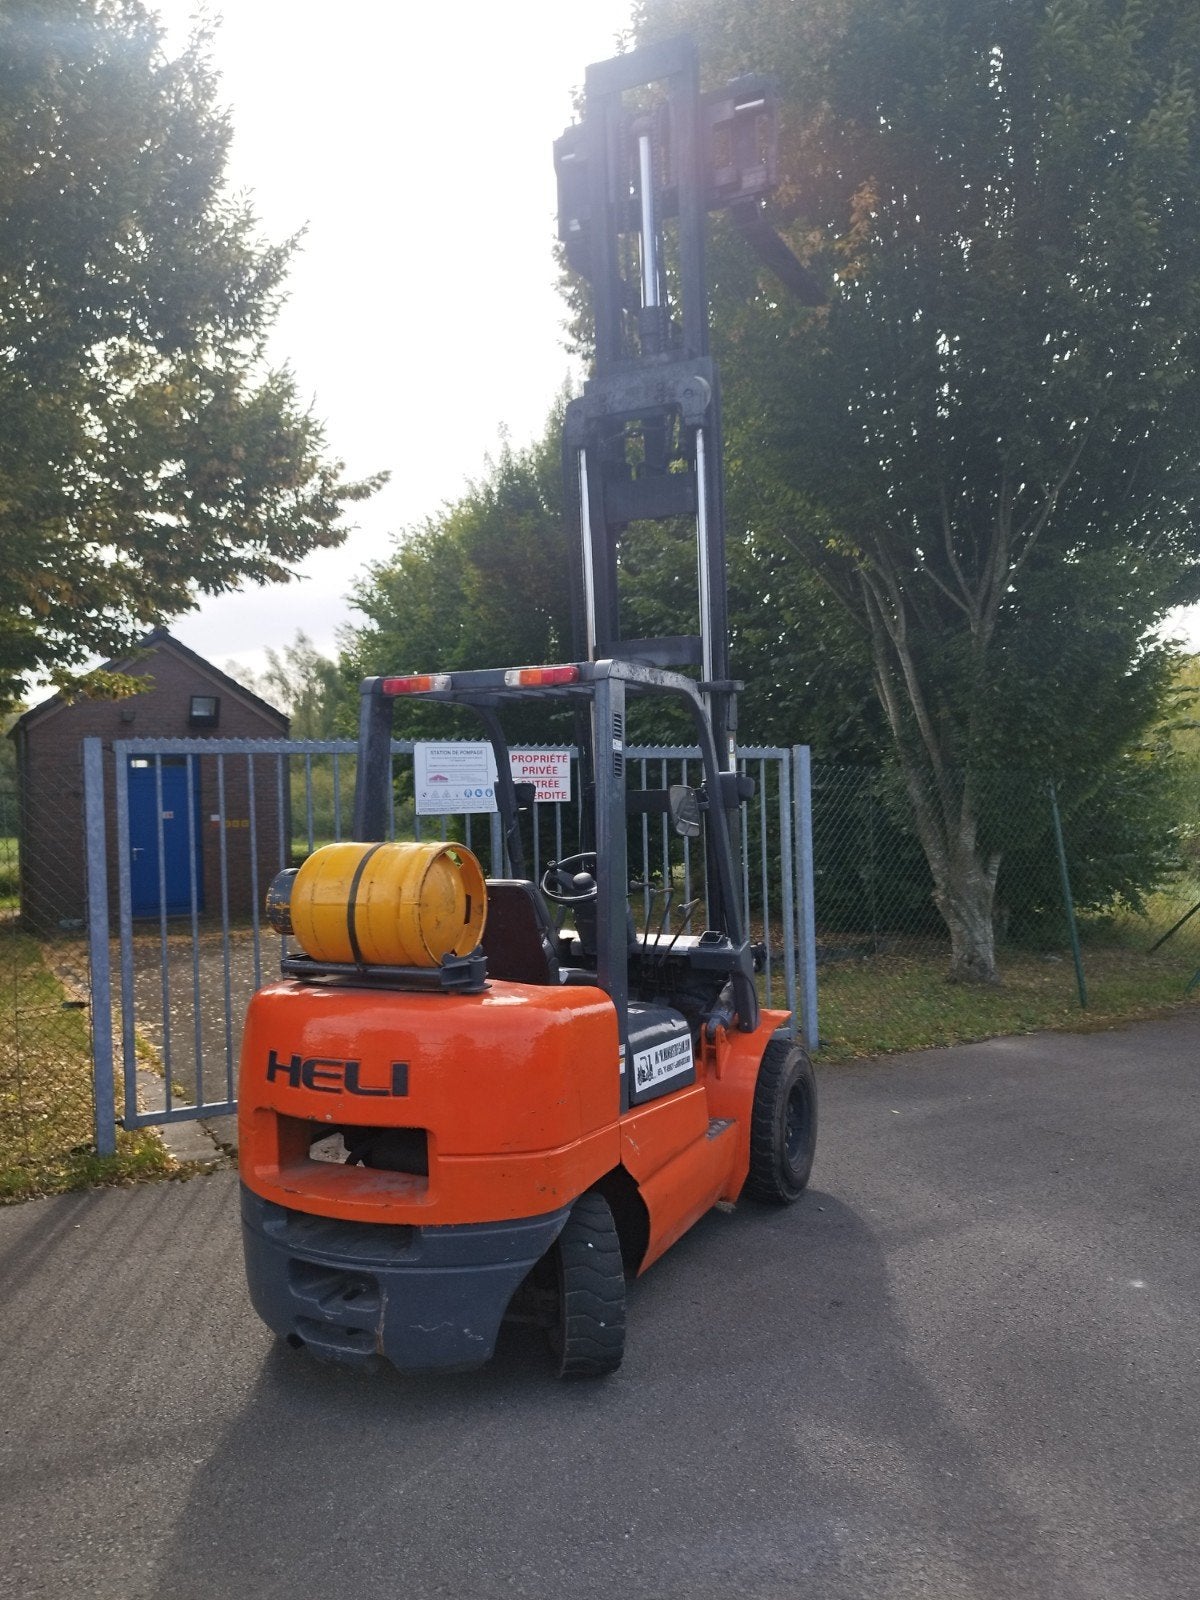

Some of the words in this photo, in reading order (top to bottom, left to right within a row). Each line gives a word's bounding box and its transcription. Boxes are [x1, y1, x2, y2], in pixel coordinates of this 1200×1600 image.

[511, 753, 568, 763] PROPRIÉTÉ
[522, 764, 558, 775] PRIVÉE
[521, 779, 560, 788] TRÉE
[533, 791, 567, 800] RDITE
[266, 1050, 409, 1097] HELI
